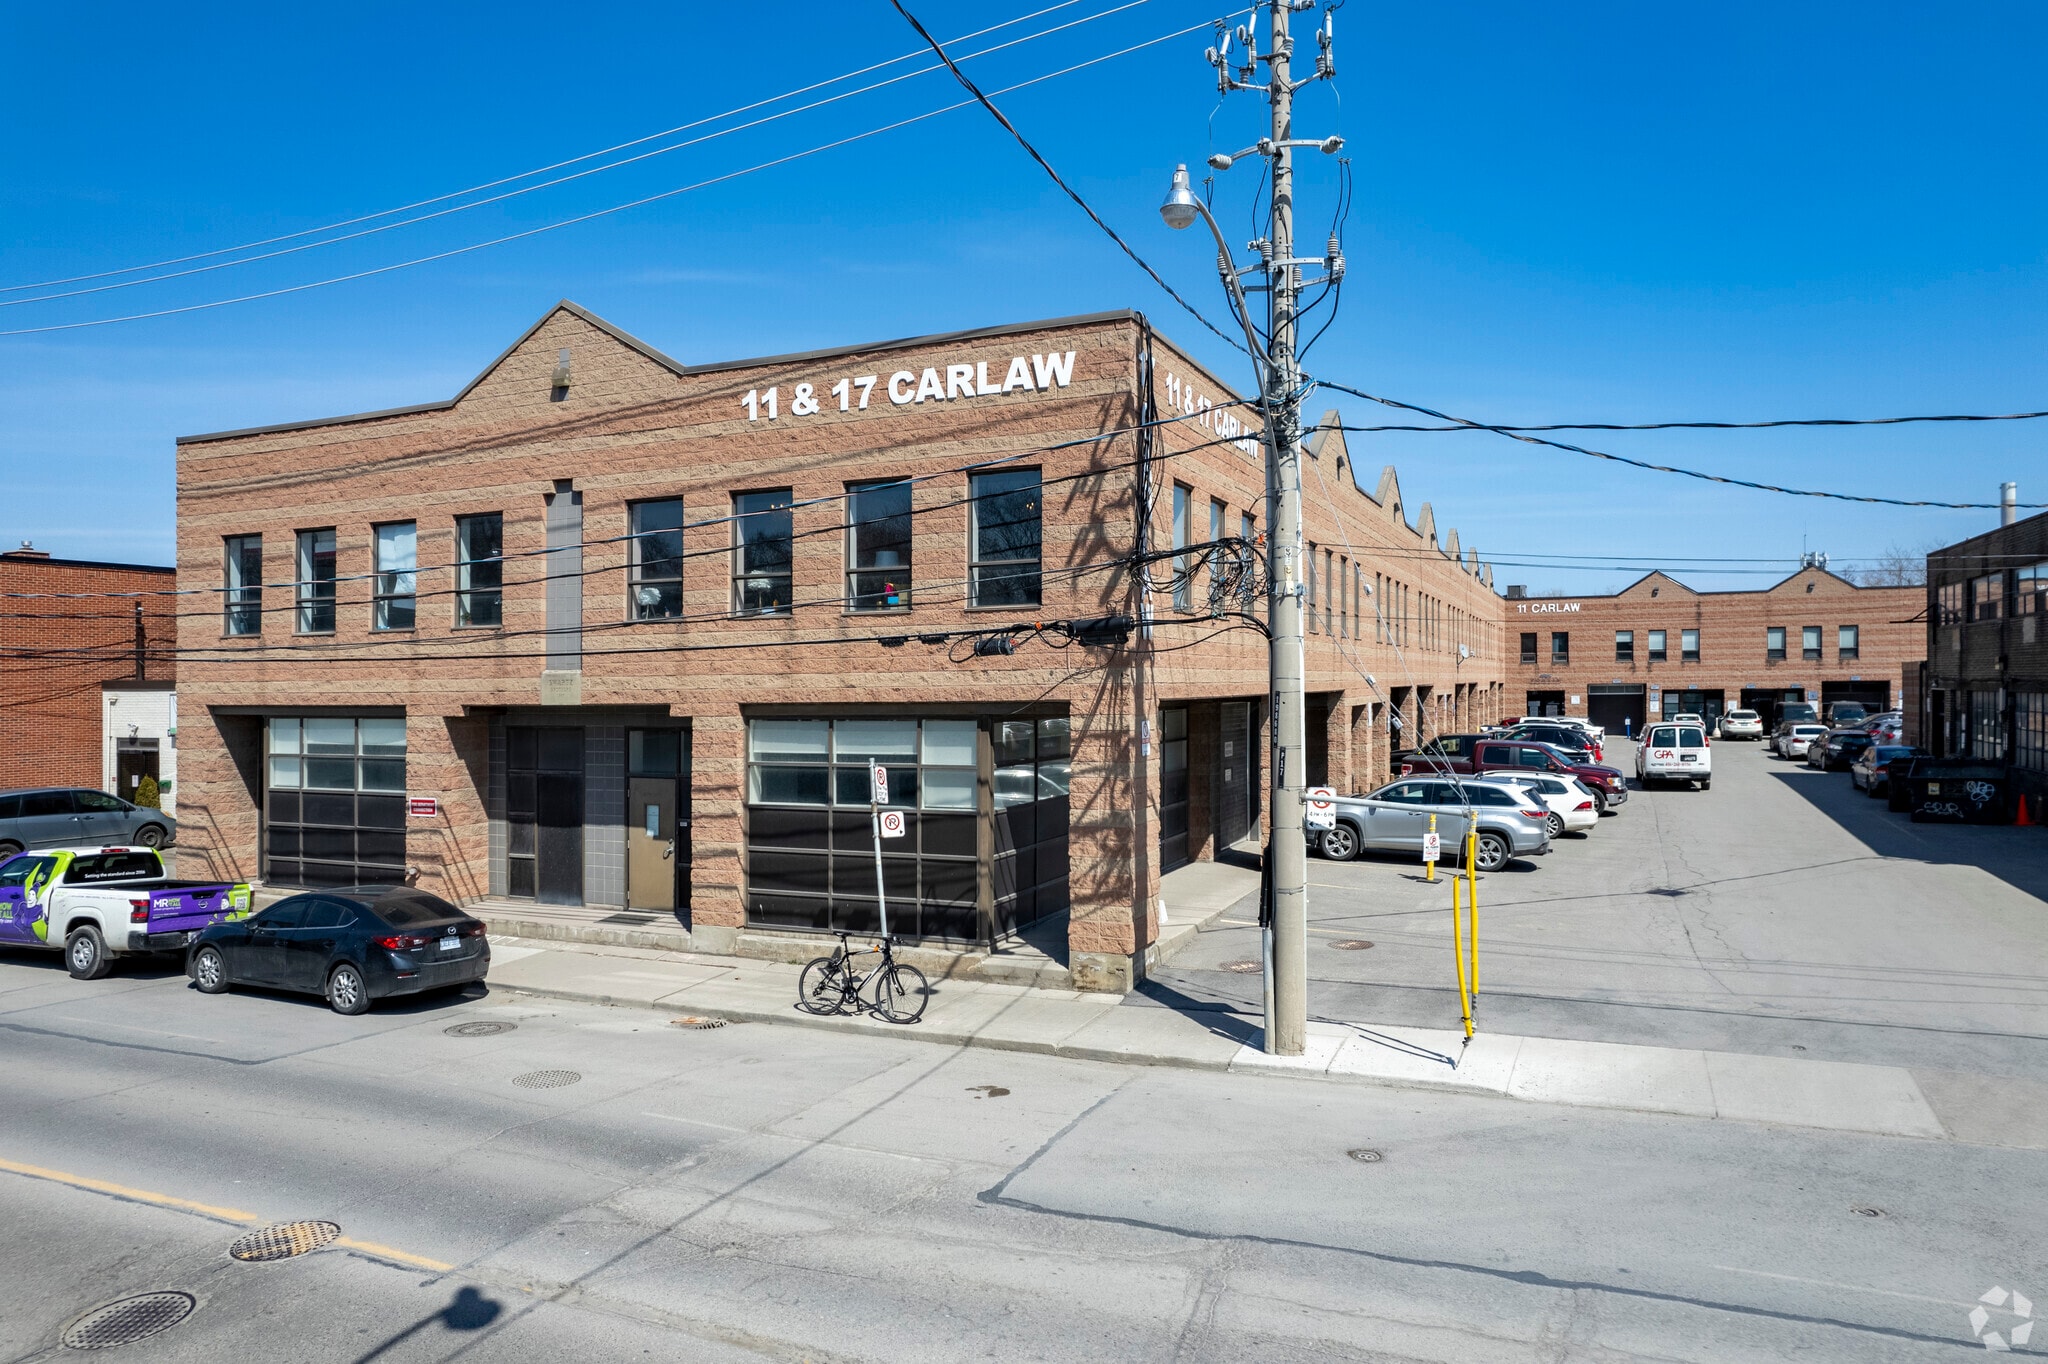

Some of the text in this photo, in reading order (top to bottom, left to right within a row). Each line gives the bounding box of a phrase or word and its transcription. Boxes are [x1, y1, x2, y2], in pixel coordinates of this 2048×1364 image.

[741, 351, 1076, 421] 11 & 17 CARLAW
[1165, 372, 1259, 460] 11 & 17 CARLAW
[1517, 603, 1581, 613] 11 CARLAW
[1654, 750, 1674, 759] GPA
[153, 898, 168, 908] MR
